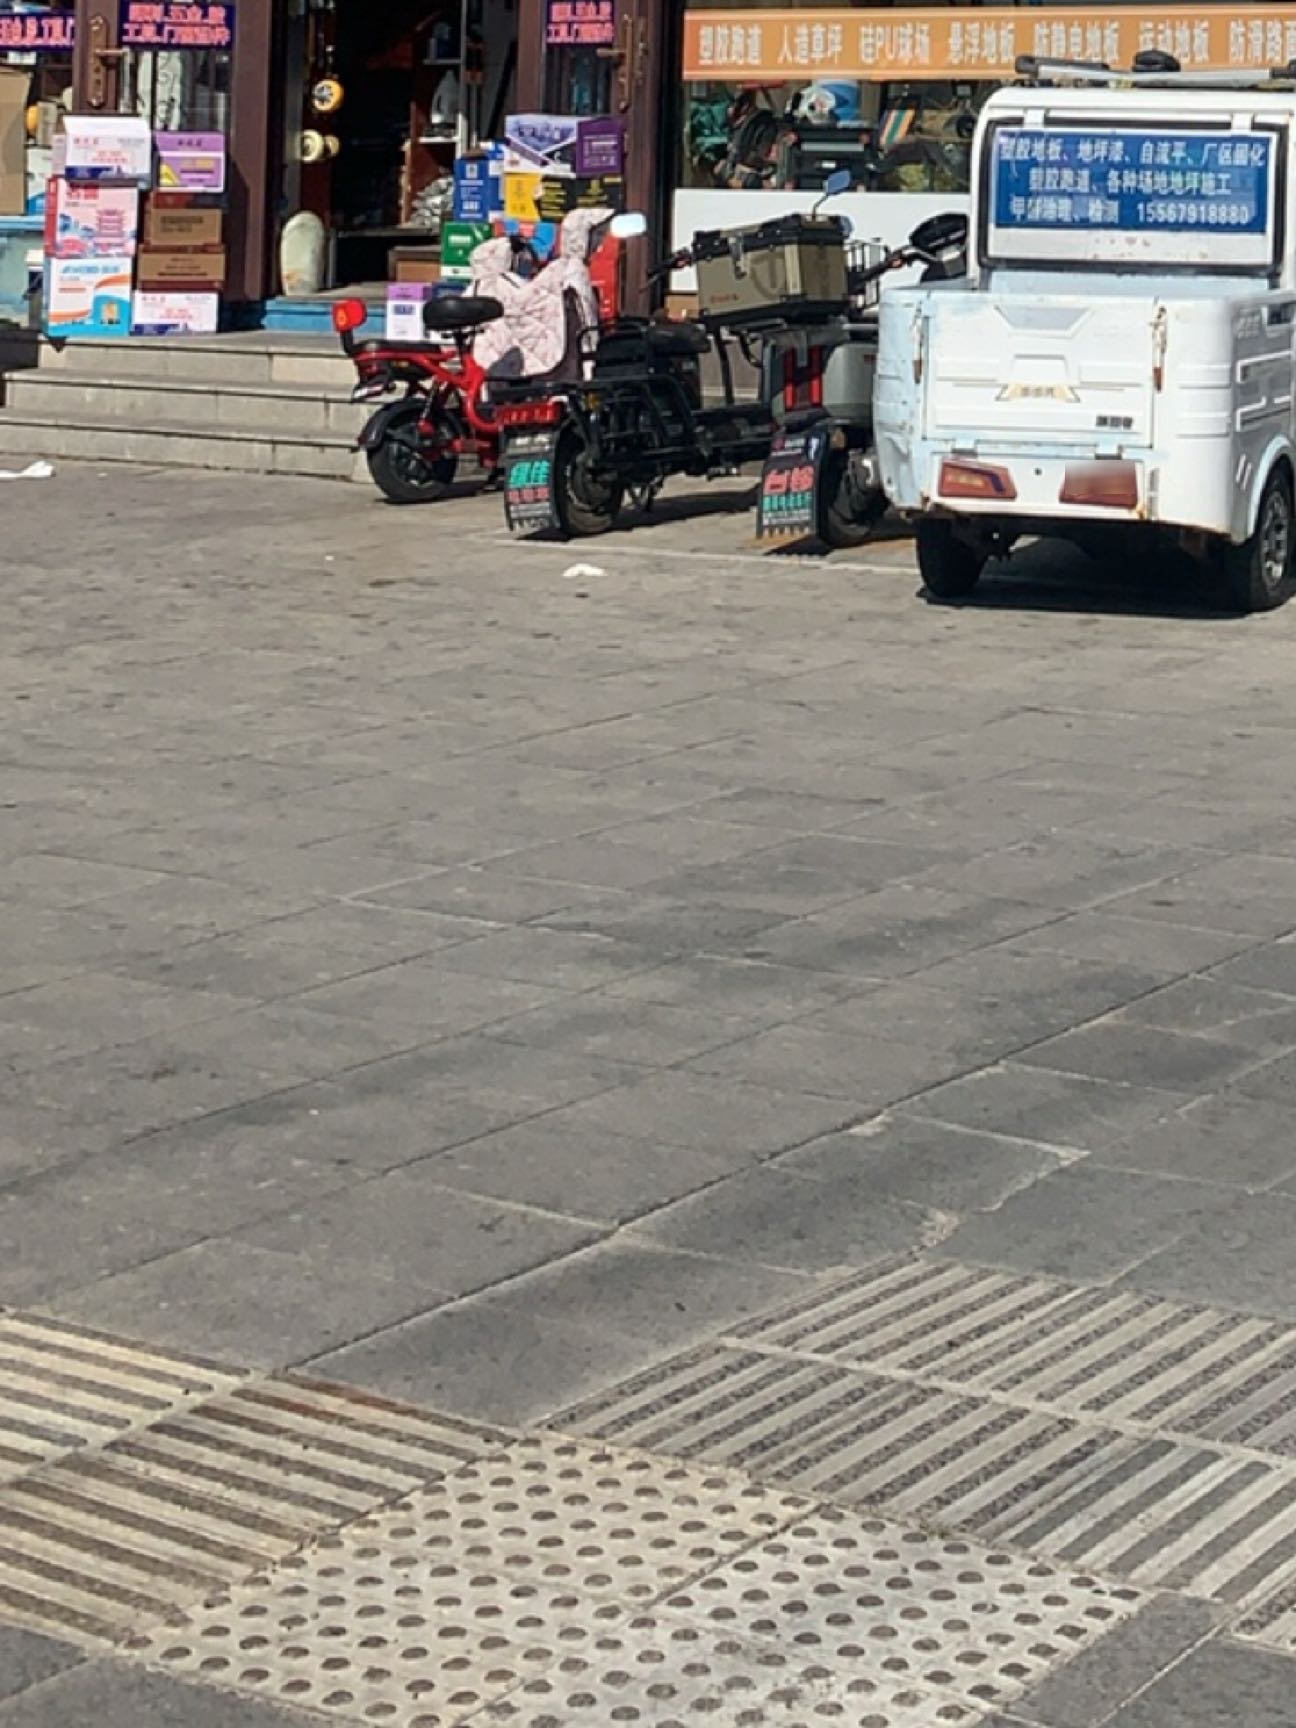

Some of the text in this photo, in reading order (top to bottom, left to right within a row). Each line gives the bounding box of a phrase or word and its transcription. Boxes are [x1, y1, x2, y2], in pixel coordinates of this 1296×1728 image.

[777, 22, 844, 66] 人造草坪
[1136, 202, 1250, 225] 15567918880
